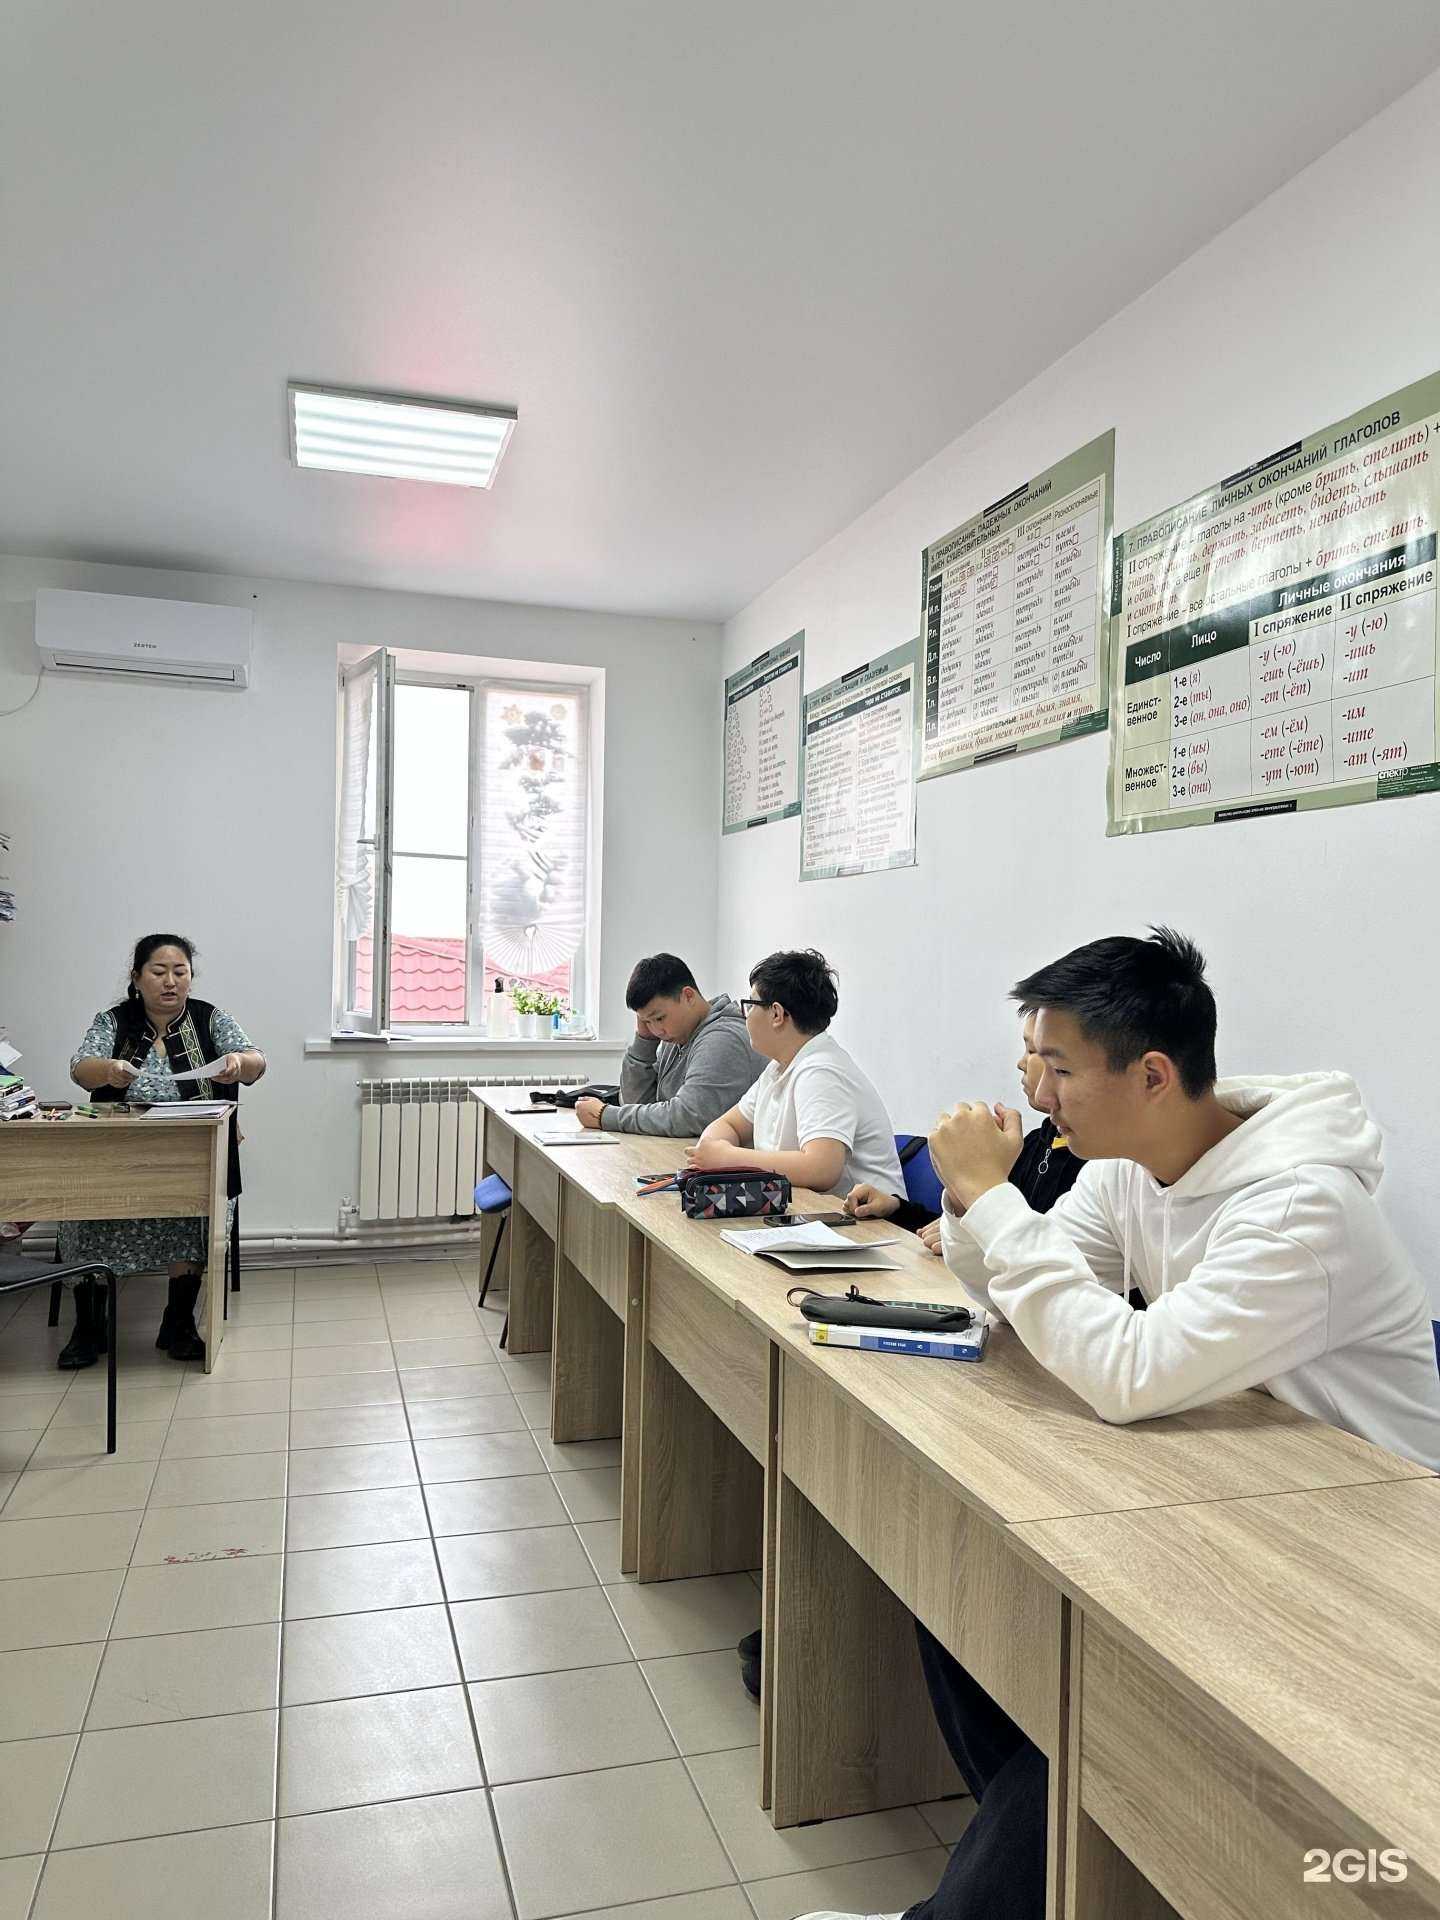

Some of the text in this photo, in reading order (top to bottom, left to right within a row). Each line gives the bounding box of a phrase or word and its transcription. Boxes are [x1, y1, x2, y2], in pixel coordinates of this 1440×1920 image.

[1136, 505, 1208, 548] ПРАВОПИСАНИЕ
[1211, 482, 1254, 513] ЛИЧНЫХ
[1258, 444, 1327, 489] ОКОНЧАНИЙ
[1333, 410, 1401, 454] ГЛАГОЛОВ
[1233, 511, 1245, 526] на
[1275, 482, 1312, 509] (кроме
[1315, 461, 1359, 491] брить,
[1363, 424, 1430, 468] стелить)
[1250, 505, 1307, 537] зависеть,
[1310, 481, 1360, 512] видеть,
[1309, 488, 1387, 530] ненавидеть
[1278, 554, 1406, 607] Личные окончания
[1188, 599, 1203, 613] все
[1263, 602, 1332, 635] спряжение
[1340, 593, 1352, 612] II
[1355, 569, 1433, 606] спряжение
[1361, 612, 1388, 637] (-ю)
[1191, 630, 1217, 649] Лицо
[1273, 638, 1297, 661] (-ю)
[1134, 650, 1162, 668] Число
[1287, 653, 1325, 679] (-ёшь)
[1173, 669, 1201, 689] 1-е (я)
[1282, 679, 1312, 702] (-ёт)
[1127, 696, 1162, 714] Единст-
[1173, 687, 1212, 708] 2-е (ты)
[1127, 711, 1158, 727] венное
[1173, 714, 1188, 728] 3-е
[1208, 704, 1228, 719] она,
[1229, 695, 1251, 714] оно)
[1281, 715, 1309, 739] (-ём)
[1173, 739, 1210, 759] 1-е (мы)
[1288, 735, 1324, 759] (-ёте)
[1372, 742, 1408, 766] (-ят)
[1125, 764, 1167, 780] Множест-
[1172, 760, 1208, 778] 2-е (вы)
[1285, 759, 1320, 781] (-ют)
[1125, 777, 1157, 793] венное
[1172, 780, 1211, 798] 3-е (они)
